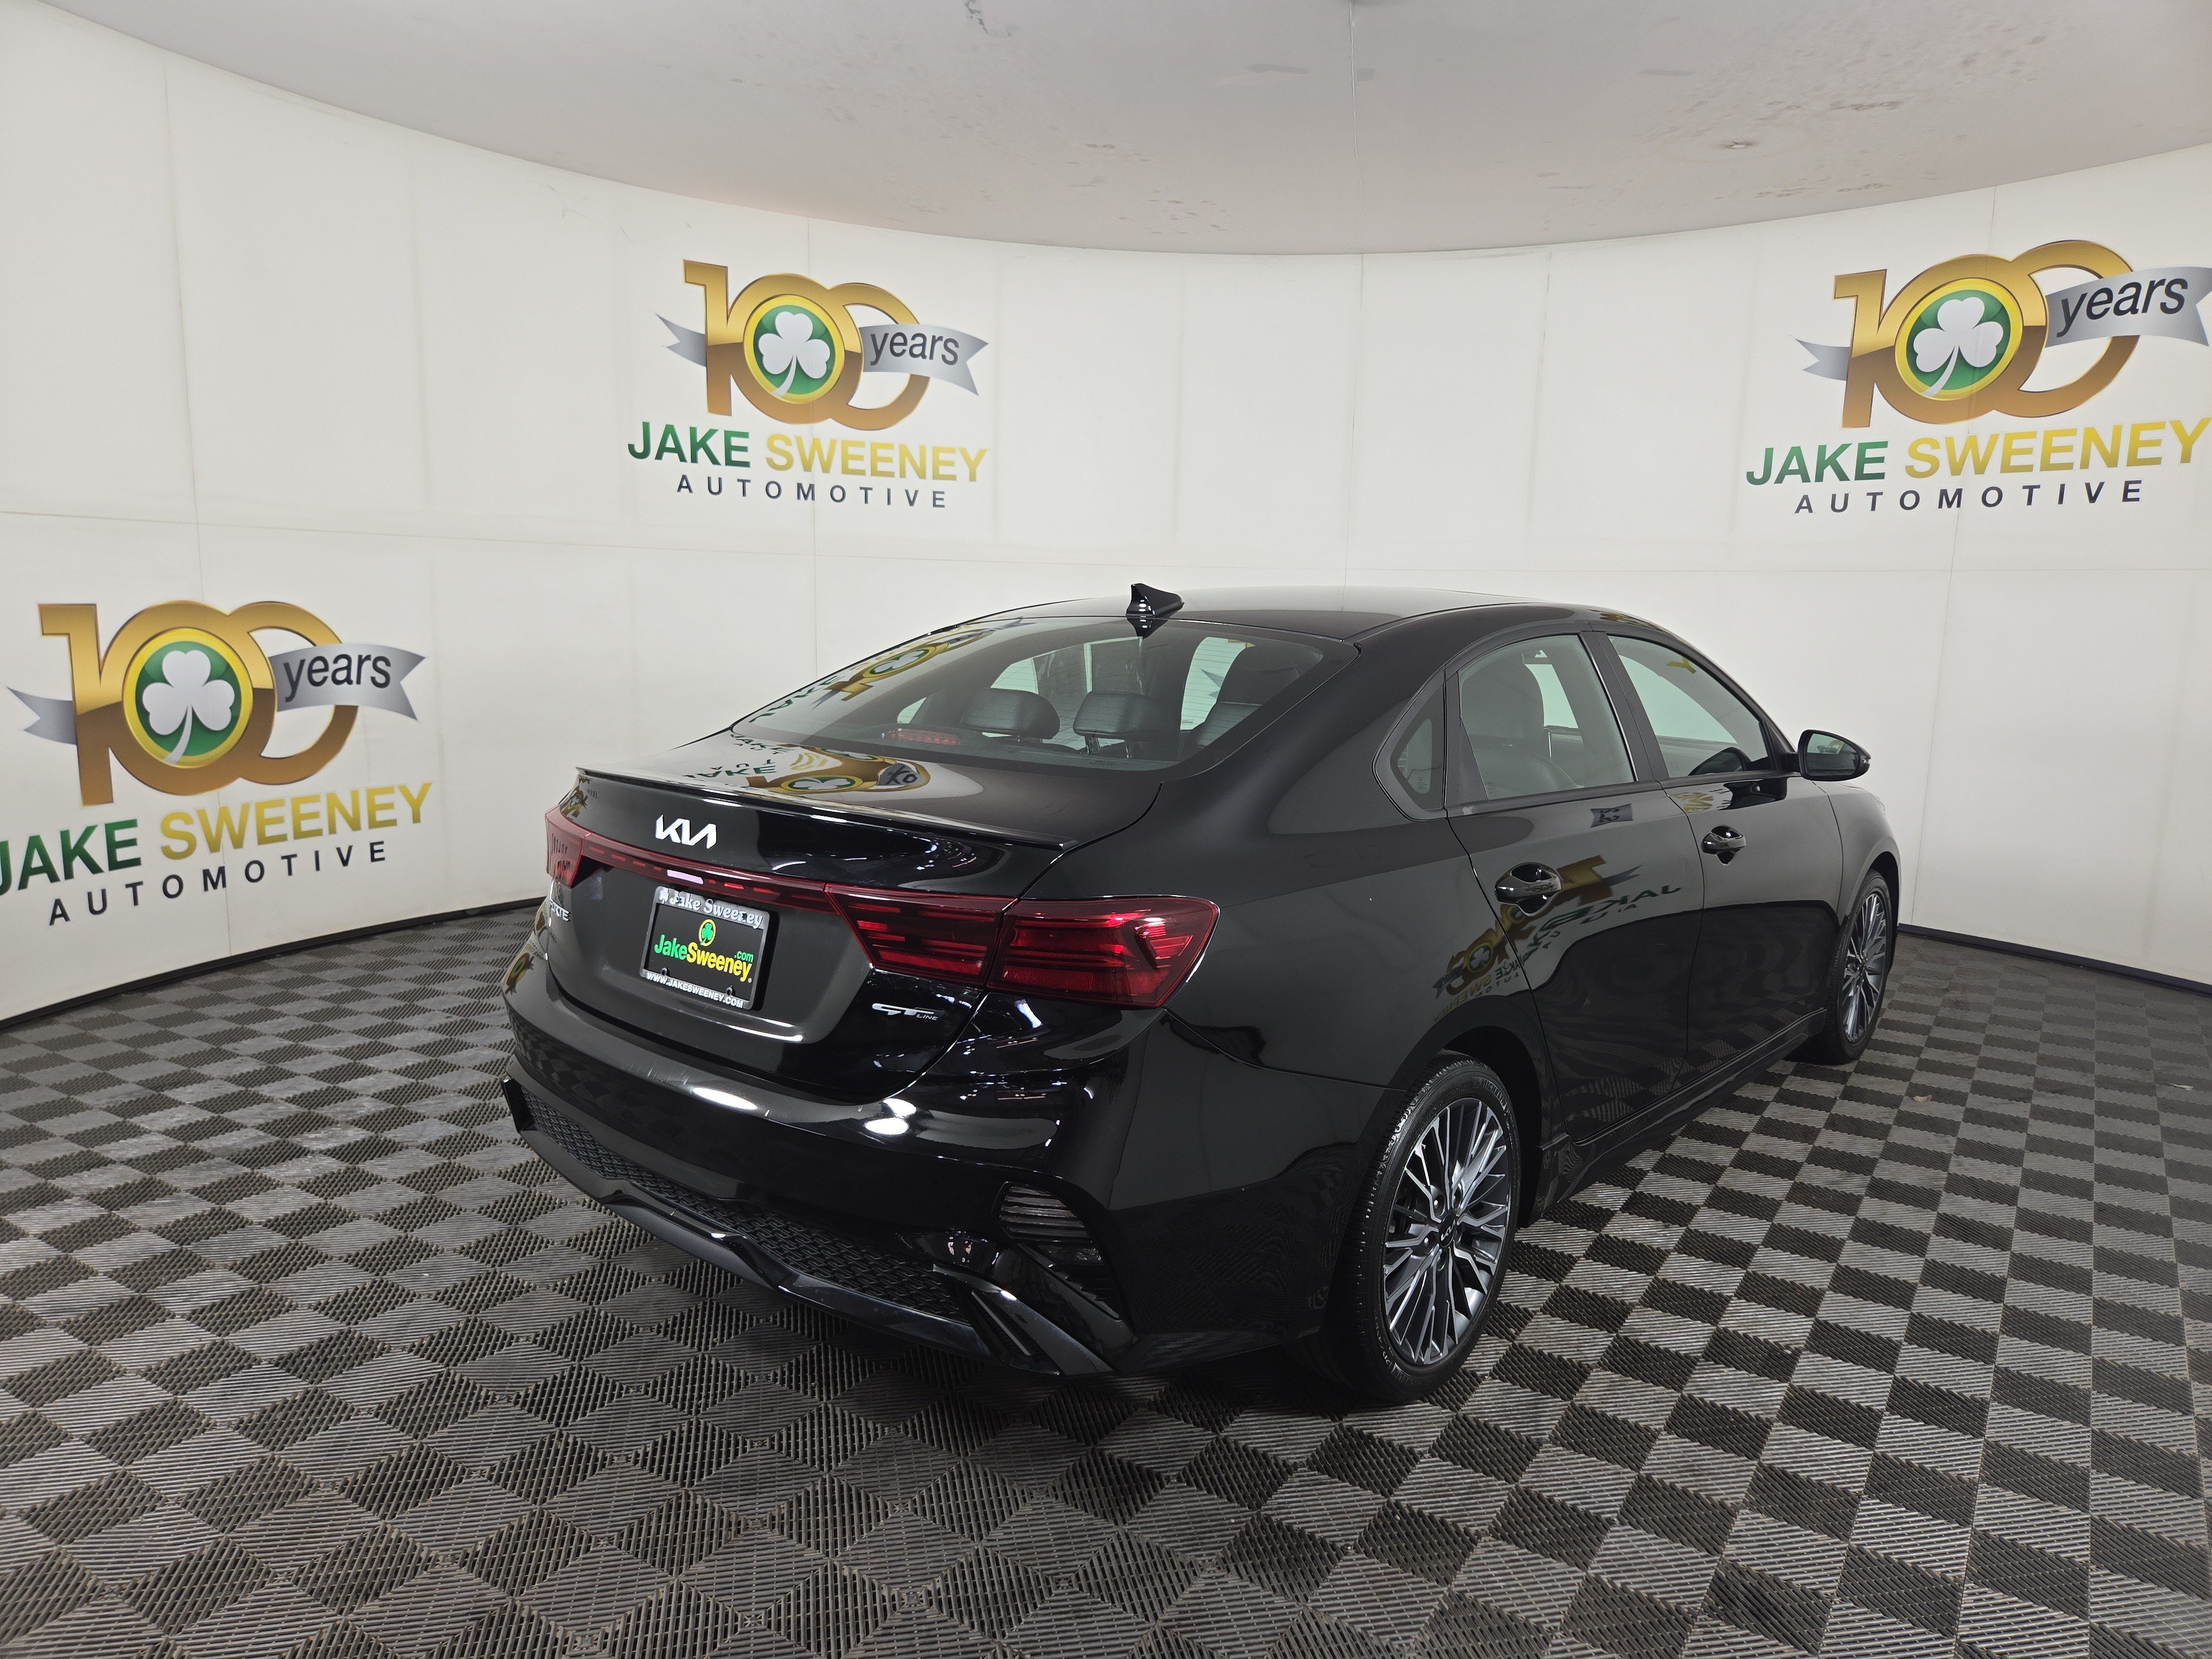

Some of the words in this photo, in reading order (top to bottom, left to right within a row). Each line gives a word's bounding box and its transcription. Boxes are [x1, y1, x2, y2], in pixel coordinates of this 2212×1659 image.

[2056, 278, 2189, 338] years
[870, 330, 960, 366] years
[627, 421, 751, 468] JAKE
[765, 433, 987, 483] SWEENEY
[1746, 440, 1889, 486] JAKE
[1904, 416, 2212, 479] SWEENEY
[676, 474, 946, 509] AUTOMOTIVE
[1794, 479, 2142, 514] AUTOMOTIVE
[283, 653, 392, 703] years
[160, 782, 432, 860] SWEENEY
[655, 814, 717, 849] KIA
[49, 841, 387, 927] AUTOMOTIVE
[646, 972, 744, 1008] WWW.JAKESWEENEY.COM
